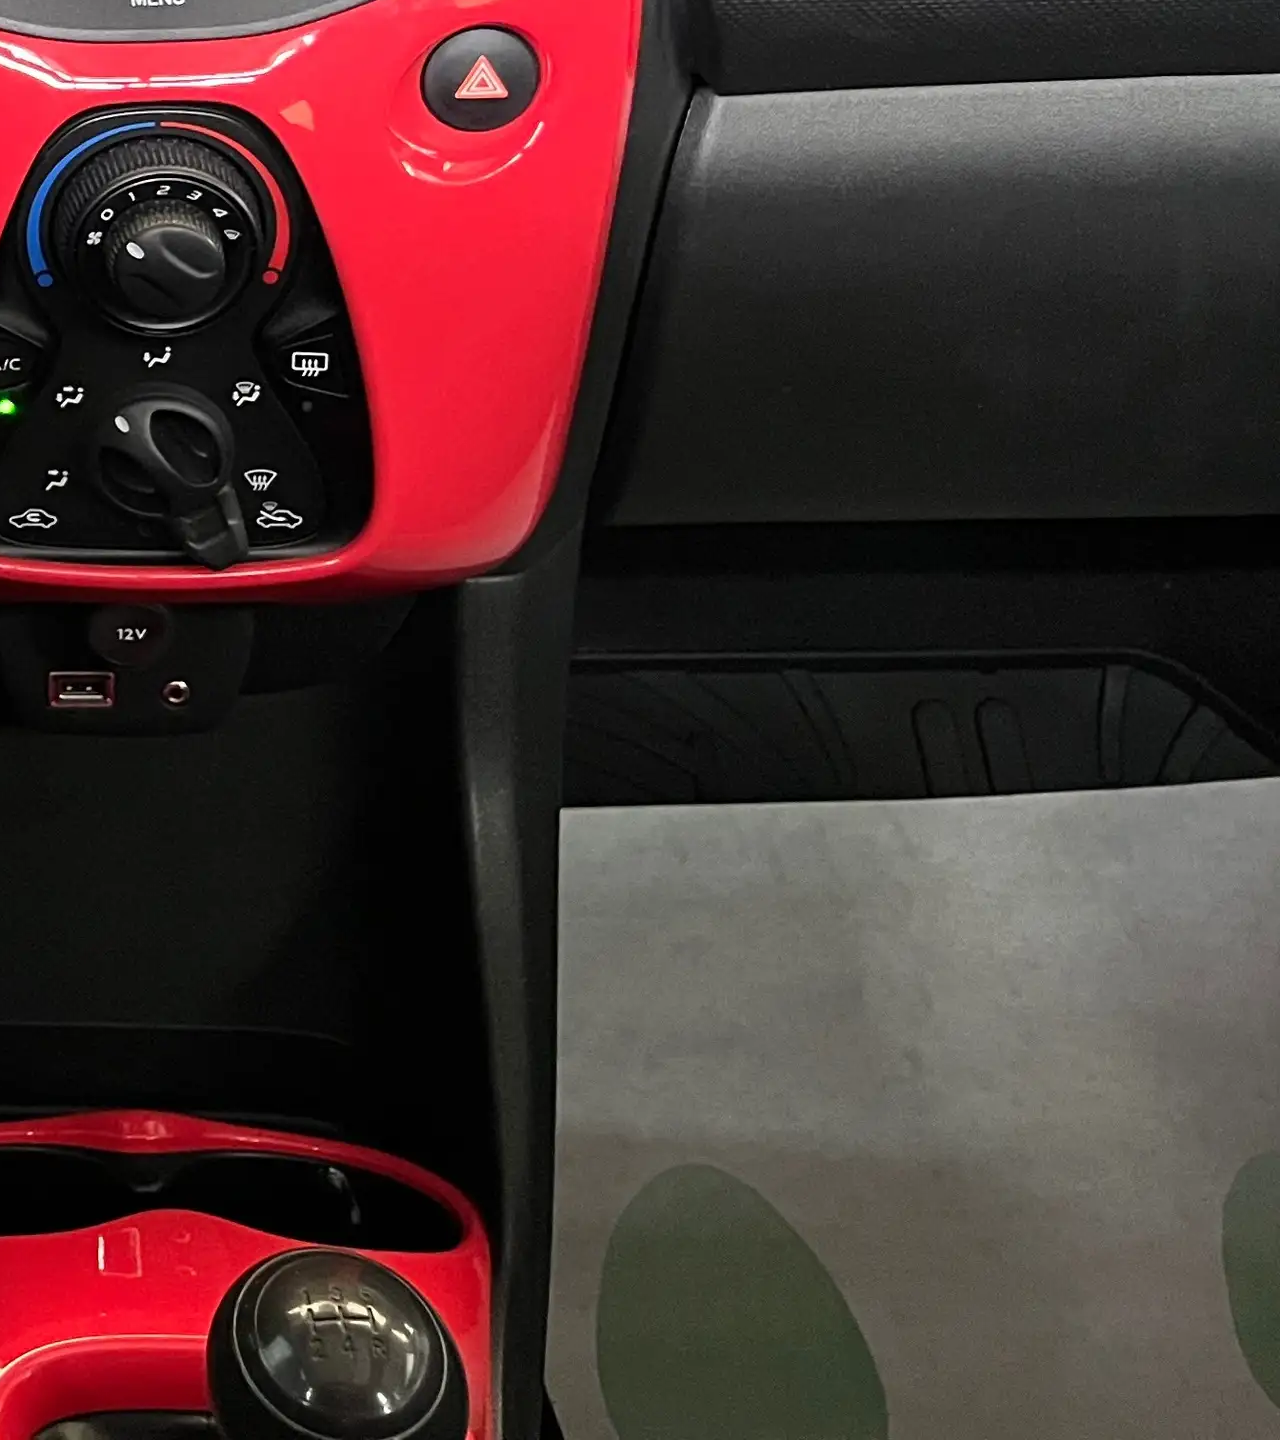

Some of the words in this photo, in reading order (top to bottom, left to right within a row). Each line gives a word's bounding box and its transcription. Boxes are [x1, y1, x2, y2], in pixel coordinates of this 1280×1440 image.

[156, 184, 171, 196] 2
[185, 189, 203, 201] 3
[127, 191, 136, 202] 1
[100, 208, 115, 221] 0
[212, 207, 229, 218] 4
[115, 627, 148, 641] 12V
